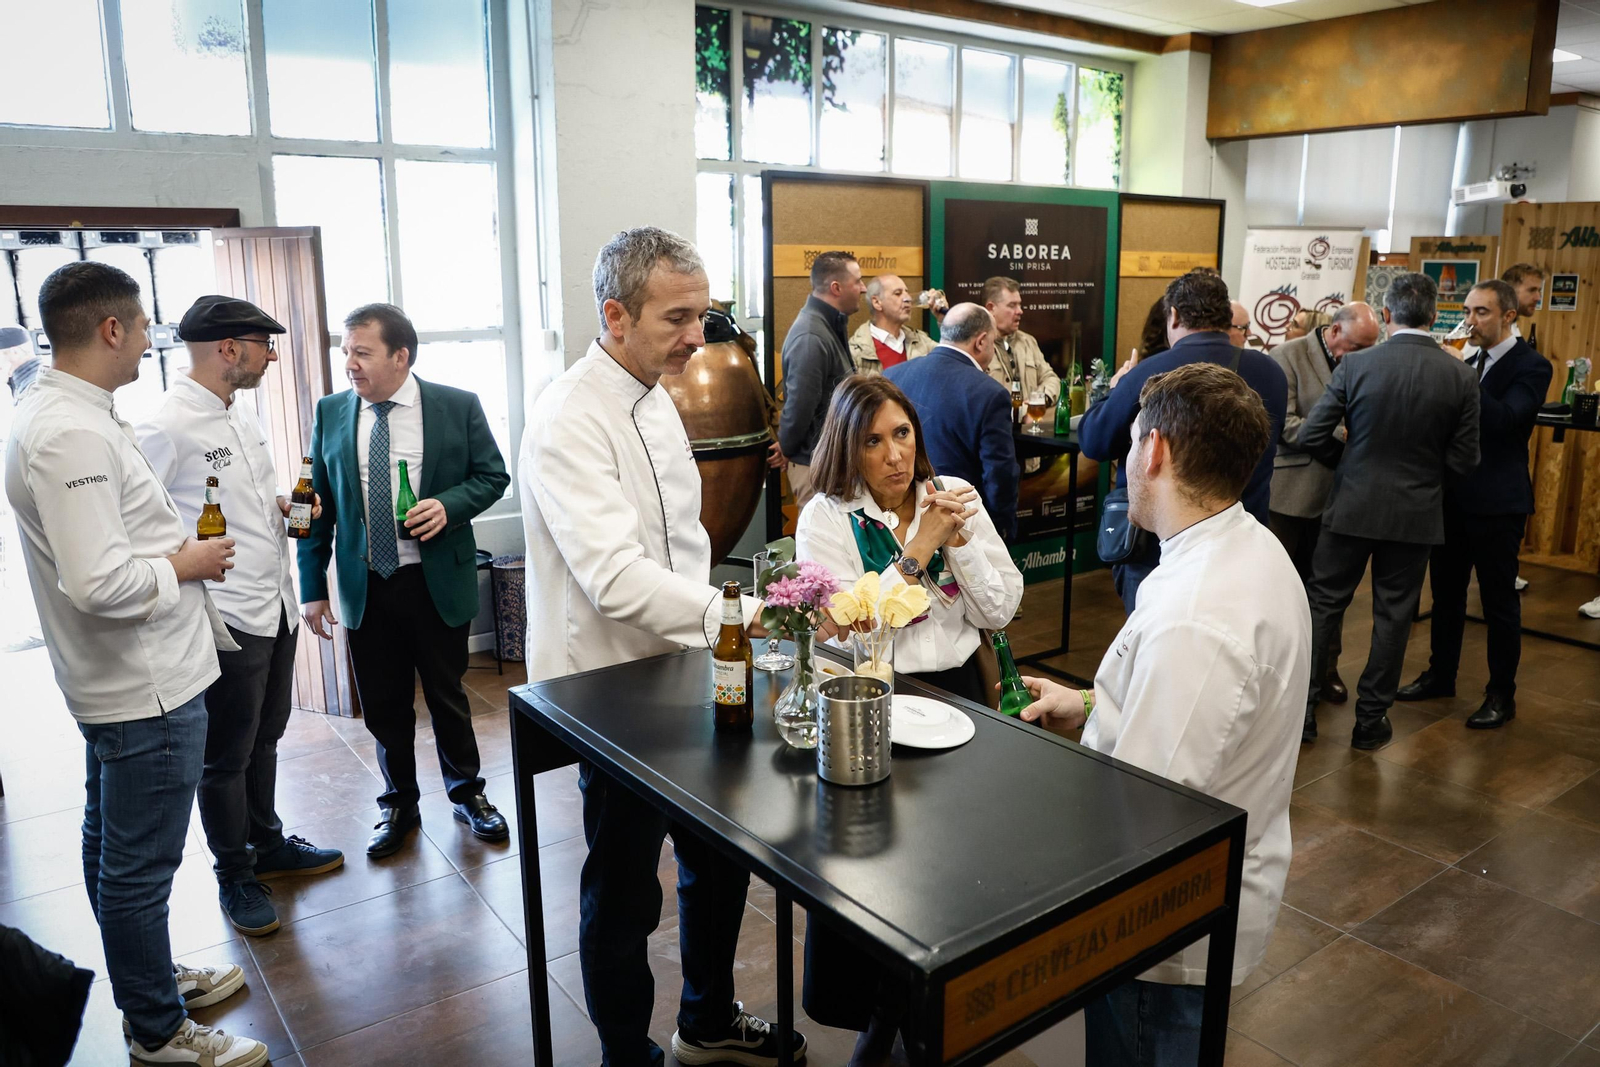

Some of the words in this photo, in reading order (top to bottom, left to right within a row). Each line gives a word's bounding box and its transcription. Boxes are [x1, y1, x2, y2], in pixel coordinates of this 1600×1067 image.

[988, 243, 1071, 260] SABOREA
[1009, 262, 1024, 271] SIN
[1027, 262, 1051, 271] PRISA
[1021, 546, 1077, 571] Alhamb
[1006, 922, 1109, 1001] CERVEZAS
[1115, 868, 1212, 943] ALHAMBRA
